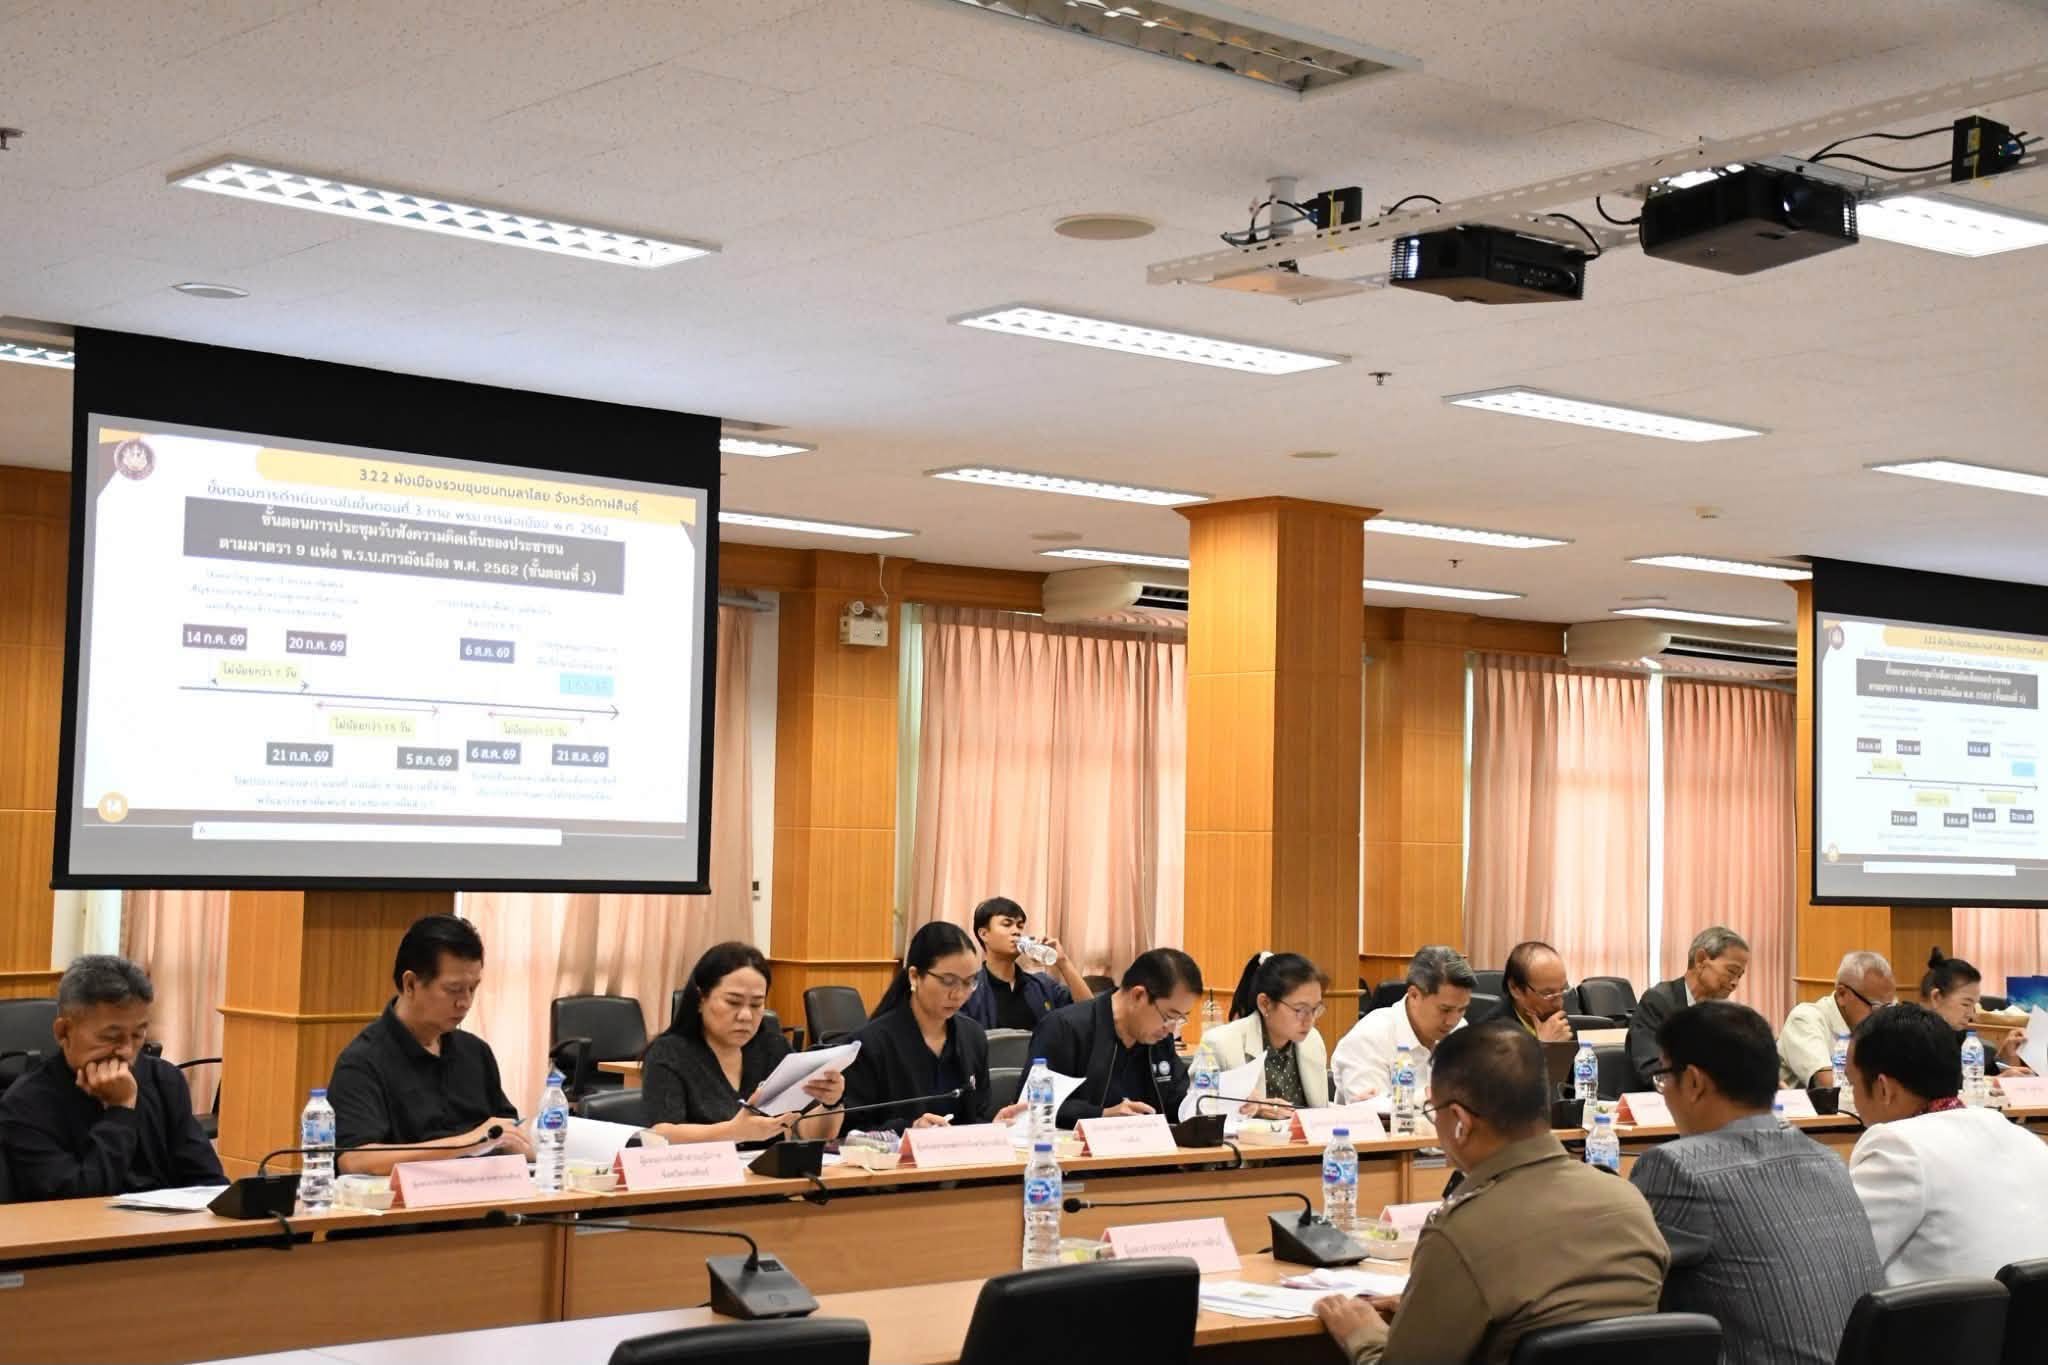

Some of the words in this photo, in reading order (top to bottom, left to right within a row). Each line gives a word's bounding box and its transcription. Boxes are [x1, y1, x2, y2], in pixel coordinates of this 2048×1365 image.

[261, 505, 564, 556] ขั้นตอนการประชุมรับฟังความคิดเห็นของประชาชน
[219, 537, 291, 555] ตามมาตรา
[296, 544, 307, 556] 9
[310, 542, 338, 559] แห่ง
[484, 563, 519, 577] 2562
[582, 570, 598, 586] 3)
[187, 630, 201, 643] 14
[230, 633, 245, 646] 69
[289, 637, 303, 649] 20
[330, 640, 345, 652] 69
[497, 647, 510, 658] 69
[272, 749, 286, 762] 21
[314, 750, 329, 763] 69
[405, 753, 413, 766] 5
[438, 755, 453, 768] 69
[503, 747, 517, 760] 69
